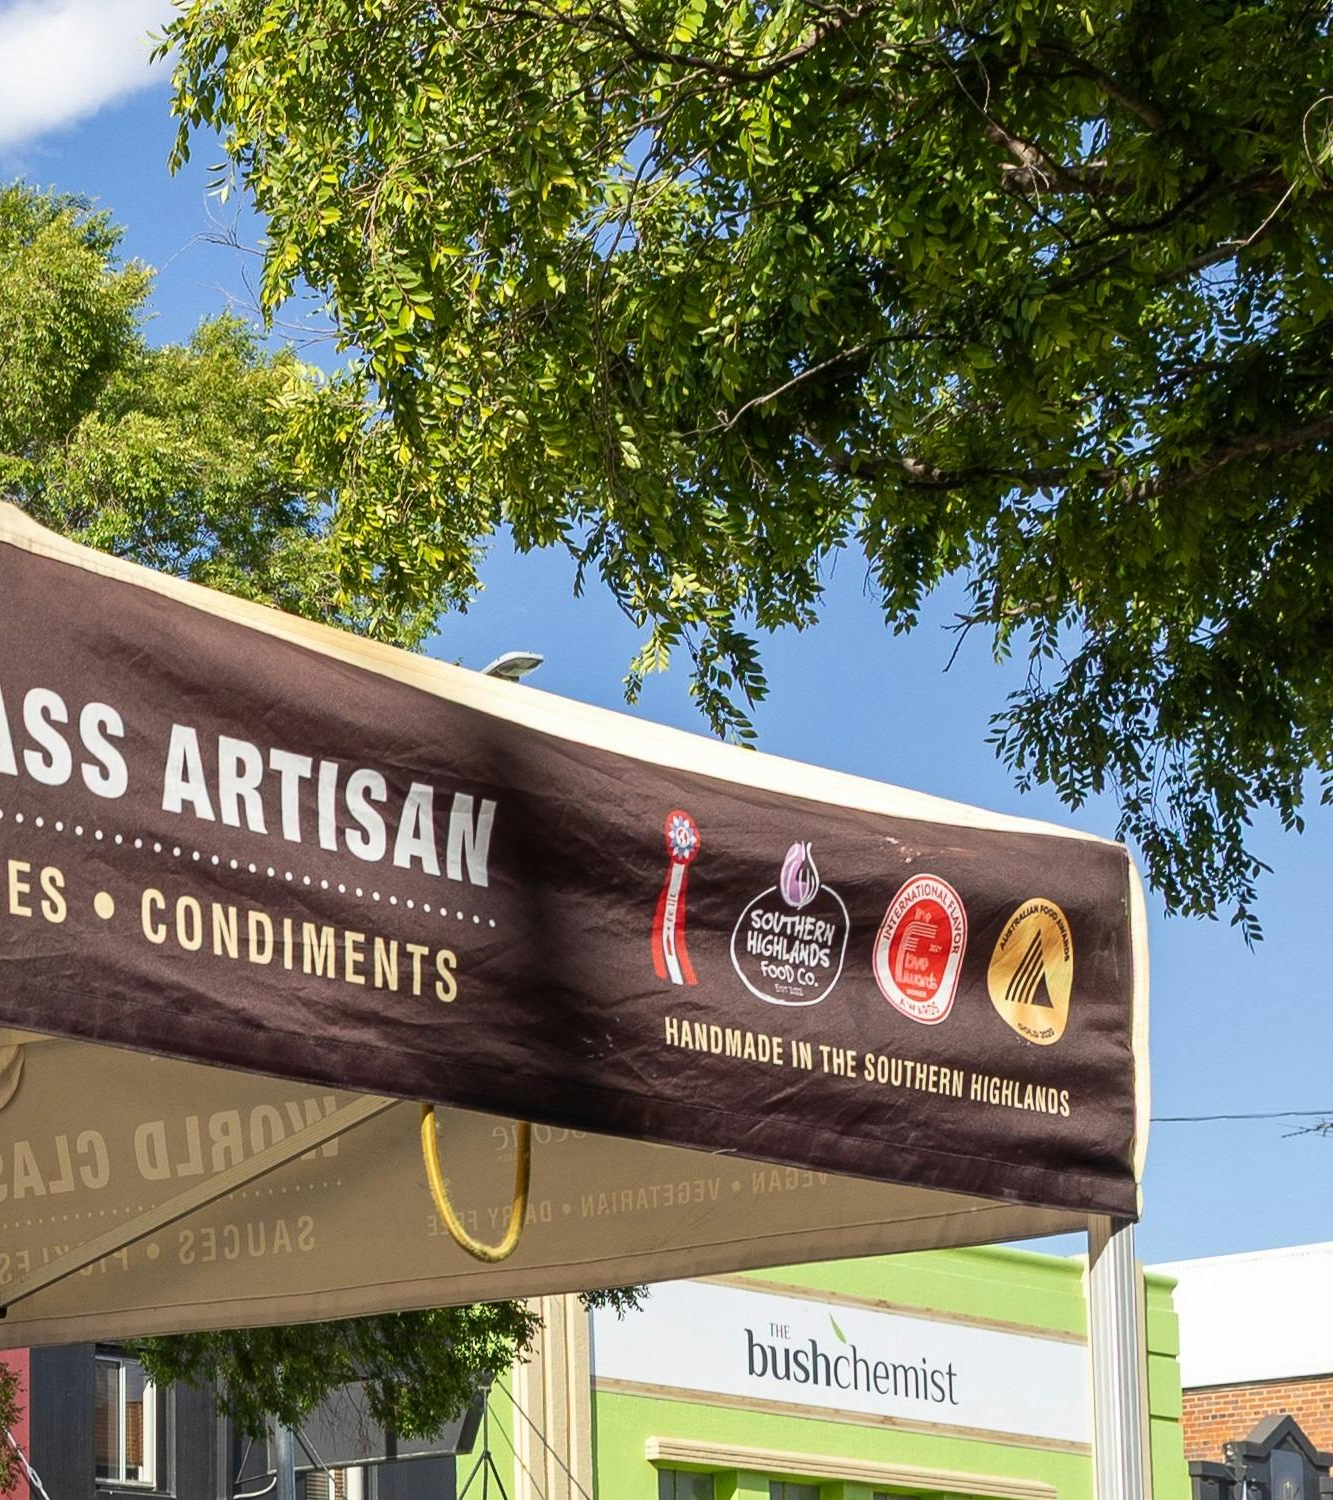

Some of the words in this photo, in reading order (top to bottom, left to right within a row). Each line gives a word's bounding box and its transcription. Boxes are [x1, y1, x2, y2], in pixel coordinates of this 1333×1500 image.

[162, 724, 498, 887] ARTISAN
[751, 909, 835, 946] SOUTHERN
[882, 881, 948, 941] INTERNATIONAL
[141, 887, 460, 1003] CONDIMENTS
[746, 930, 831, 968] HIGHLANDS
[760, 961, 795, 983] FOOD
[665, 1017, 783, 1066] HANDMADE
[792, 1041, 813, 1071] IN
[819, 1045, 857, 1077] THE
[864, 1053, 963, 1098] SOUTHERN
[970, 1074, 1070, 1118] HIGHLANDS
[770, 1322, 791, 1340] THE
[744, 1328, 959, 1406] bushchemist
